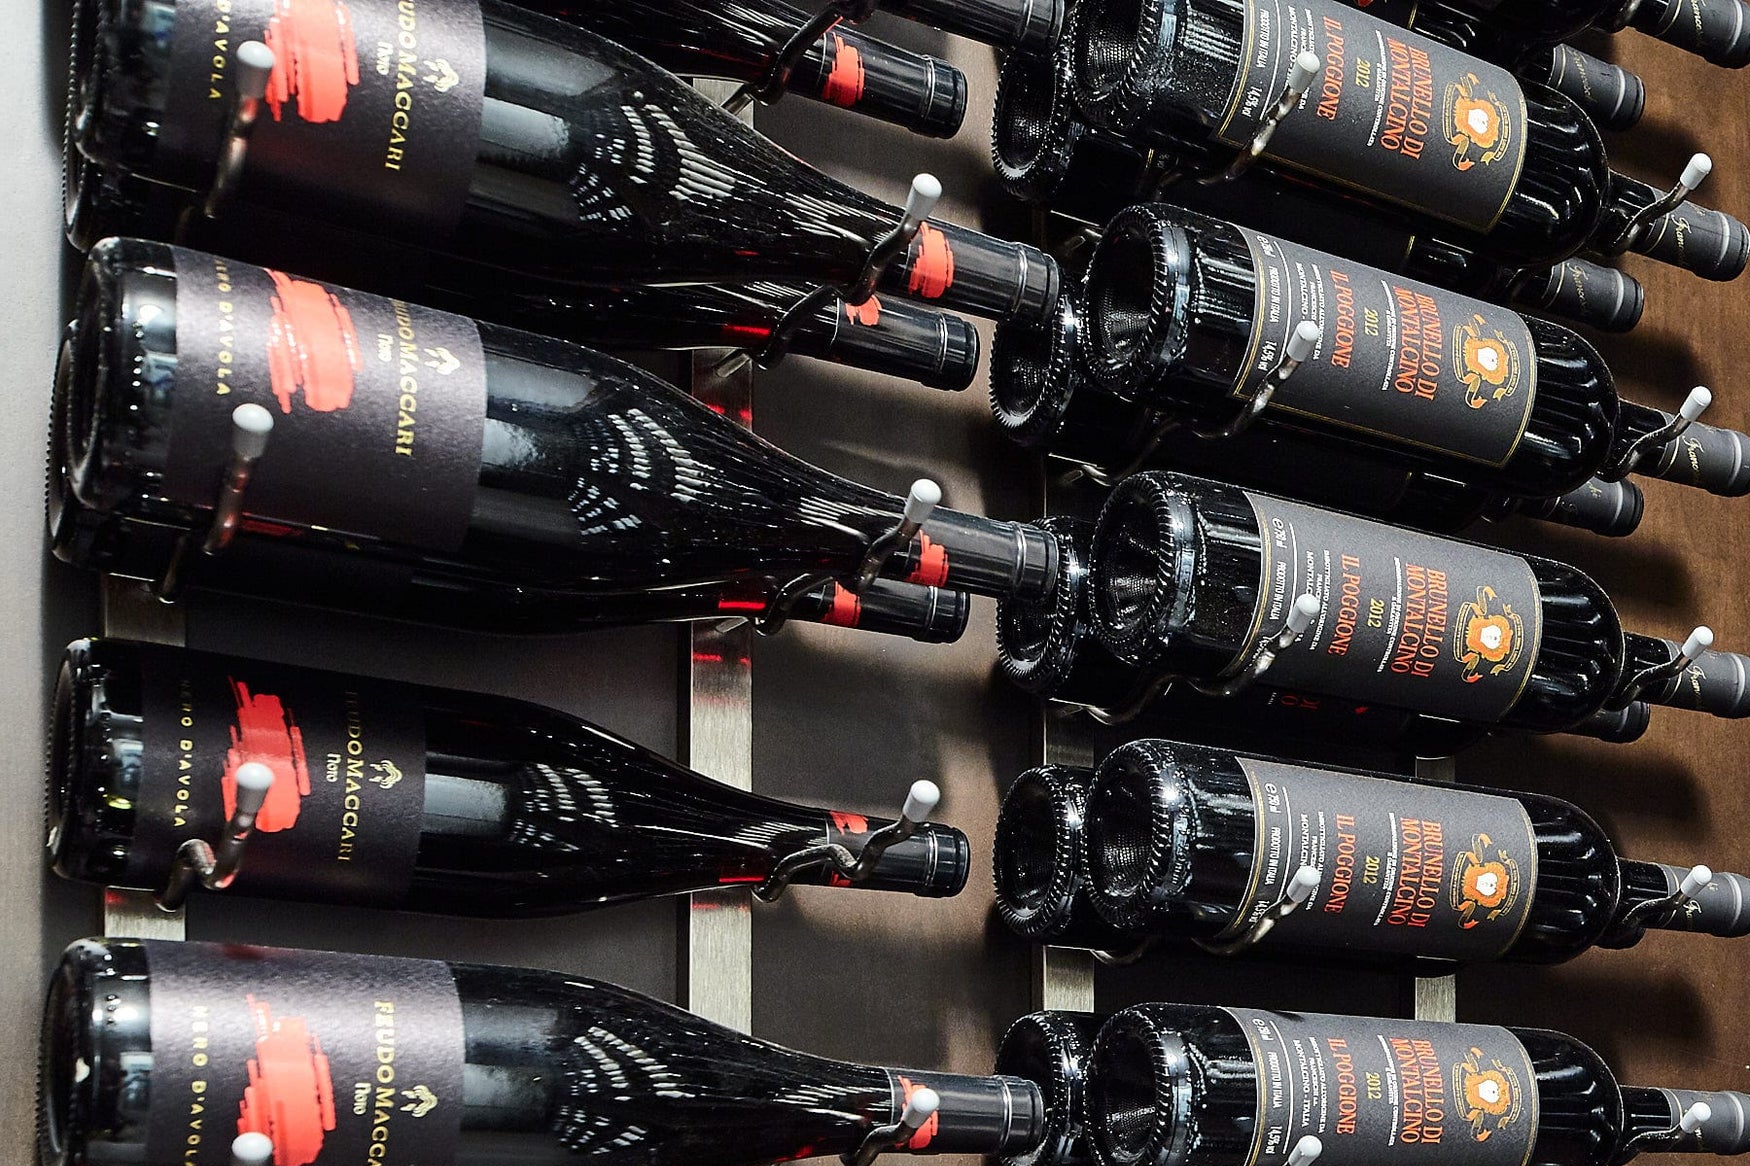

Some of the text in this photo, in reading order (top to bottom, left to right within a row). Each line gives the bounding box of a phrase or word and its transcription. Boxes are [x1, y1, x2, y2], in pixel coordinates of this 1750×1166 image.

[386, 51, 416, 171] MACCARI
[1316, 16, 1345, 121] IL POGGIONE
[1356, 57, 1371, 88] 2012
[1380, 37, 1410, 151] MONTALCINO
[1400, 45, 1433, 160] BRUNELLO DI
[213, 301, 232, 396] D'AVOLA
[1329, 269, 1356, 370] IL POGGIONE
[1364, 306, 1379, 337] 2012
[1392, 285, 1422, 393] MONTALCINO
[1414, 292, 1443, 401] BRUNELLO DI
[393, 342, 420, 458] MACCARI
[1327, 553, 1361, 656] IL POGGIONE
[1367, 598, 1384, 628] 2012
[1390, 562, 1425, 674] MONTALCINO
[1411, 567, 1448, 678] BRUNELLO DI
[172, 740, 193, 828] D'AVOLA
[337, 758, 364, 862] MACCARI
[1324, 813, 1356, 914] IL POGGIONE
[1363, 855, 1380, 885] 2012
[1386, 817, 1422, 927] MONTALCINO
[1407, 820, 1443, 928] BRUNELLO DI
[191, 1006, 209, 1067] NERO
[374, 1000, 395, 1079] FEUDO
[1327, 1037, 1357, 1135] IL POGGIONE
[1365, 1072, 1381, 1100] 2012
[1301, 1099, 1310, 1128] ITALIA
[1388, 1037, 1423, 1144] MONTALCINO
[1411, 1039, 1444, 1144] BRUNELLO DI
